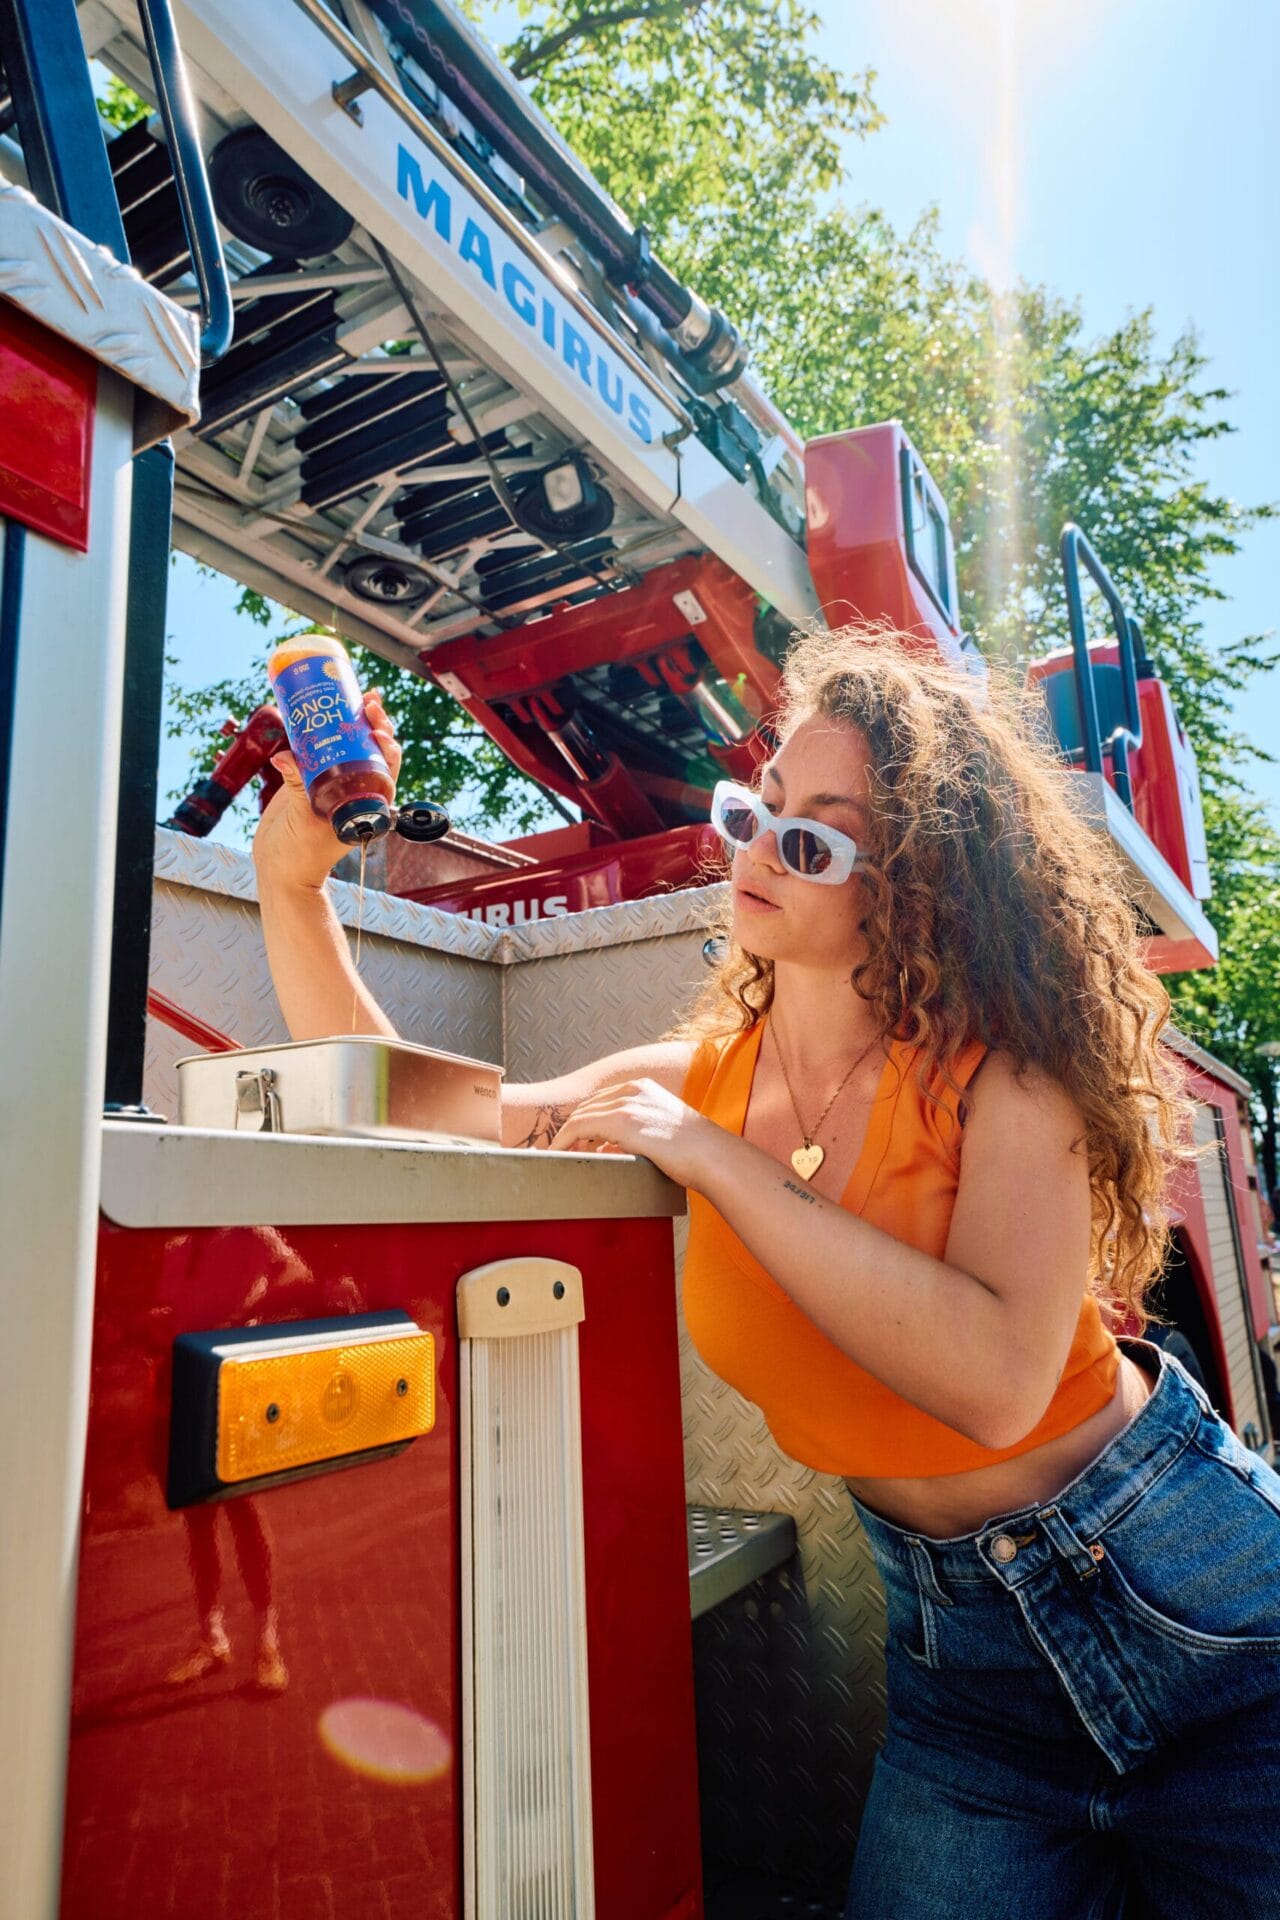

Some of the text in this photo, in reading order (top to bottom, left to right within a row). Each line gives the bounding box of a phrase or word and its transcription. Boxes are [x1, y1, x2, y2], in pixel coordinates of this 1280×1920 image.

[397, 143, 652, 444] MAGIRUS
[287, 693, 350, 727] HONEY
[302, 709, 344, 734] HOT
[455, 896, 568, 927] IRUS
